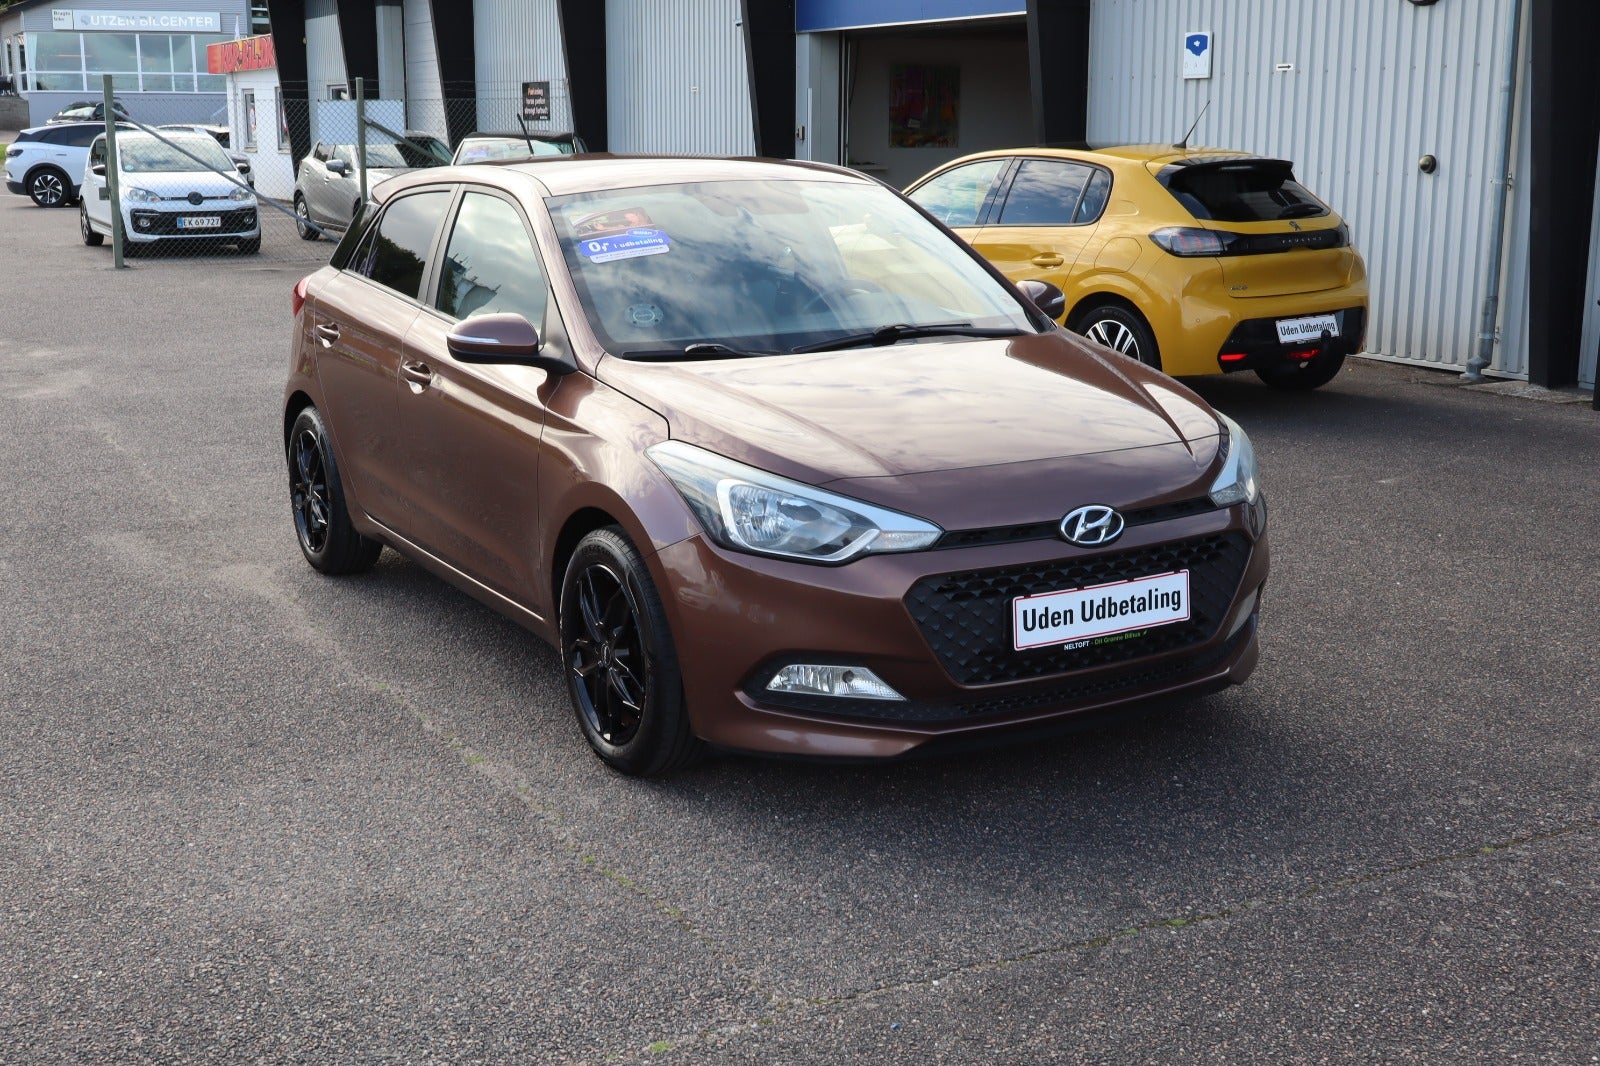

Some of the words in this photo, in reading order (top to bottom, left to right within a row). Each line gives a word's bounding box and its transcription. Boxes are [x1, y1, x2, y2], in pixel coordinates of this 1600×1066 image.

[194, 218, 205, 226] 69
[206, 218, 220, 226] 727
[1279, 325, 1299, 336] Uden
[1299, 320, 1336, 334] Udbetaling
[1022, 606, 1074, 632] Uden
[1081, 588, 1181, 623] Udbetaling
[1064, 640, 1090, 651] NELTOFT
